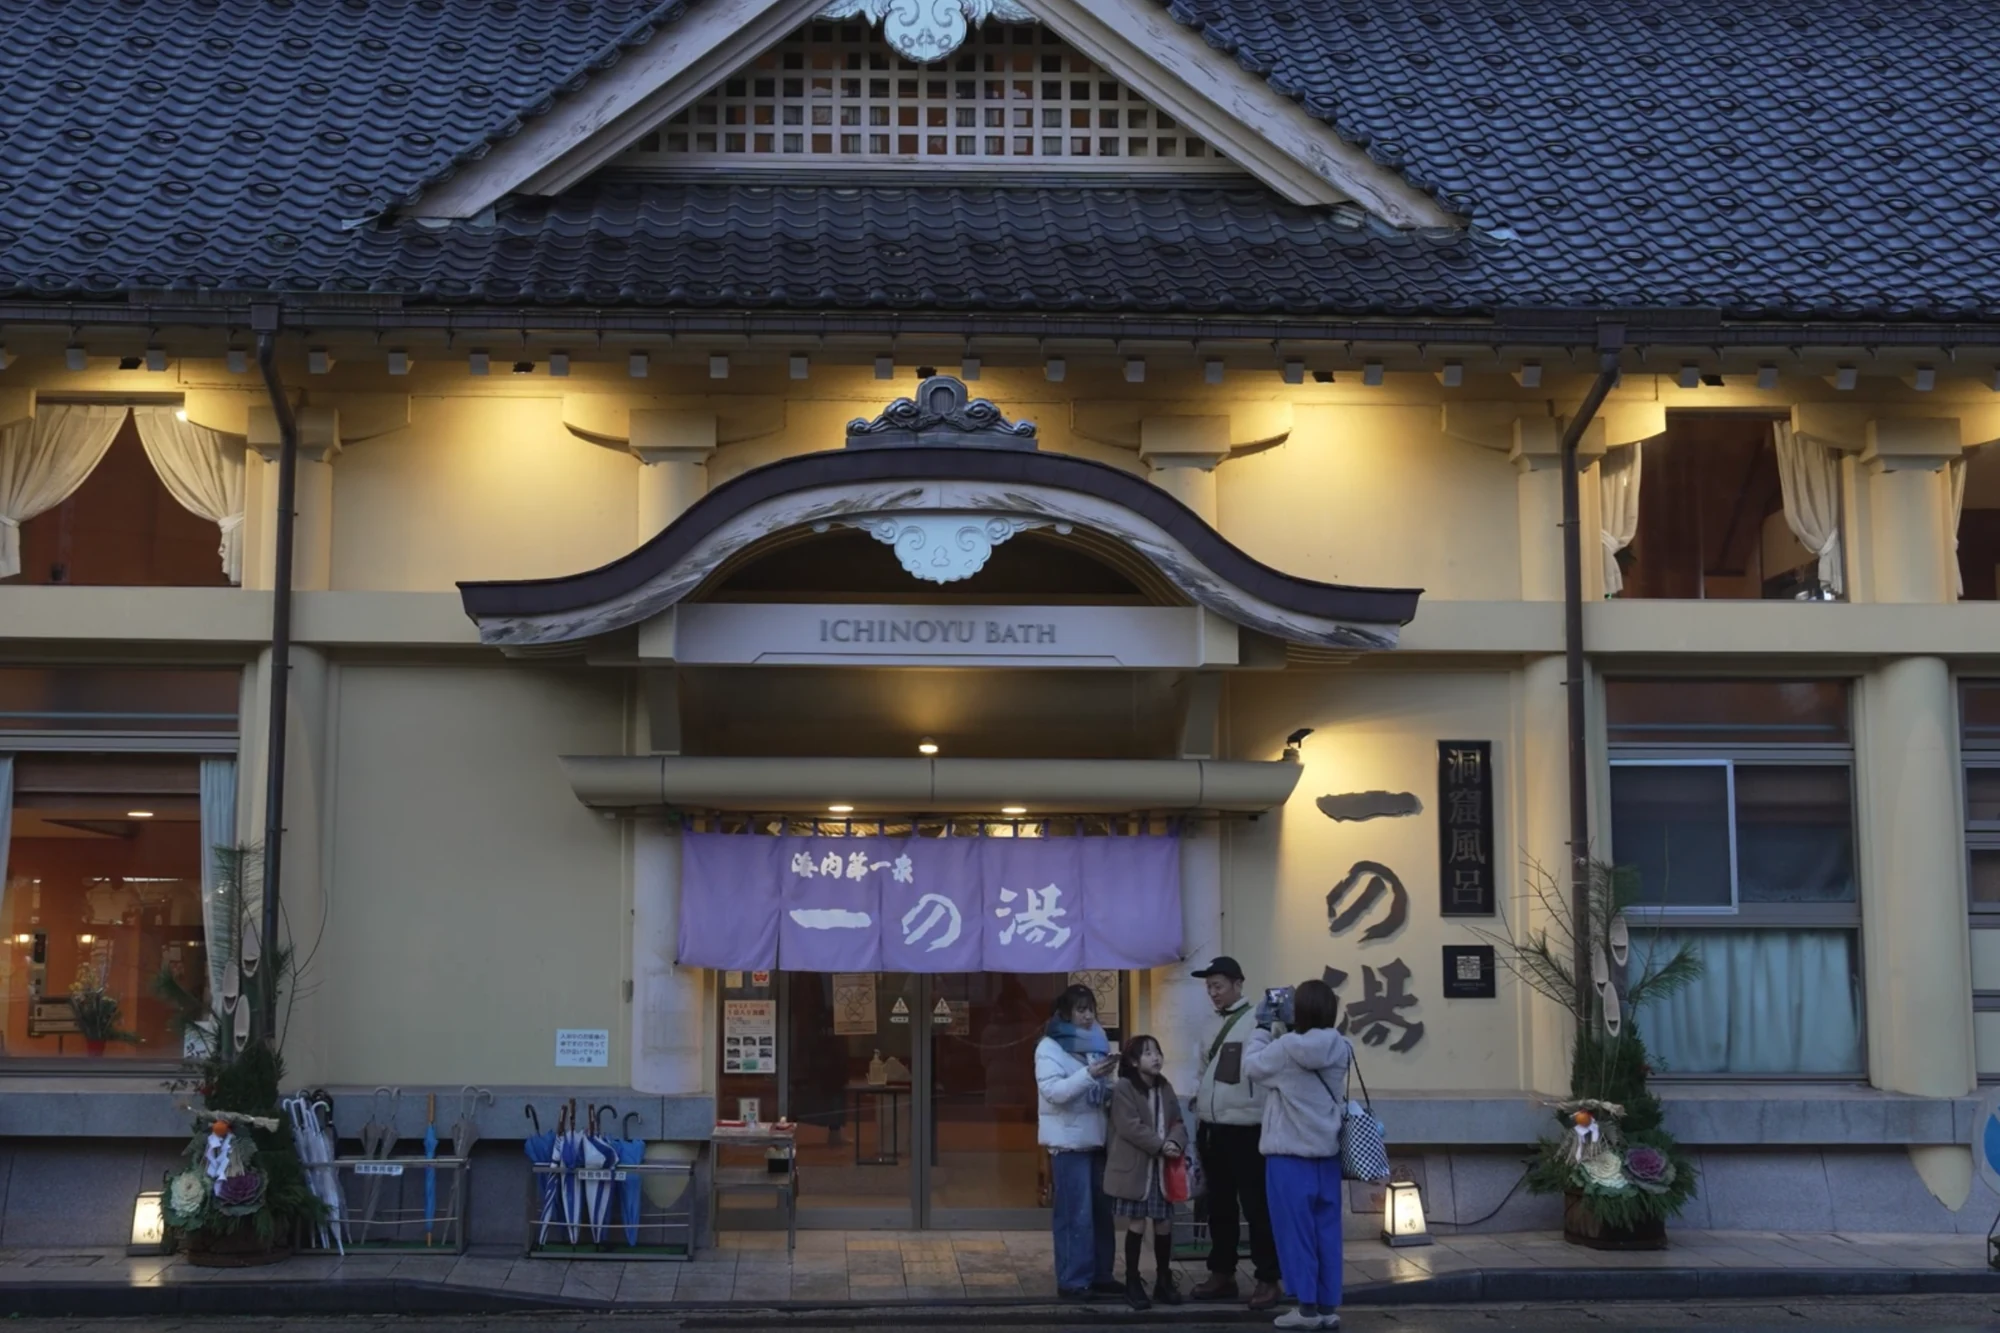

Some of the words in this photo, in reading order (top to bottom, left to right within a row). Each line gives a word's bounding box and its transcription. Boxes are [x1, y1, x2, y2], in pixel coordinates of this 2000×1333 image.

[819, 619, 975, 644] ICHINOYU
[985, 621, 1057, 644] BATH
[1447, 748, 1486, 906] 洞窟風呂
[788, 883, 1072, 952] 一の湯
[1315, 790, 1425, 1053] 一の湯
